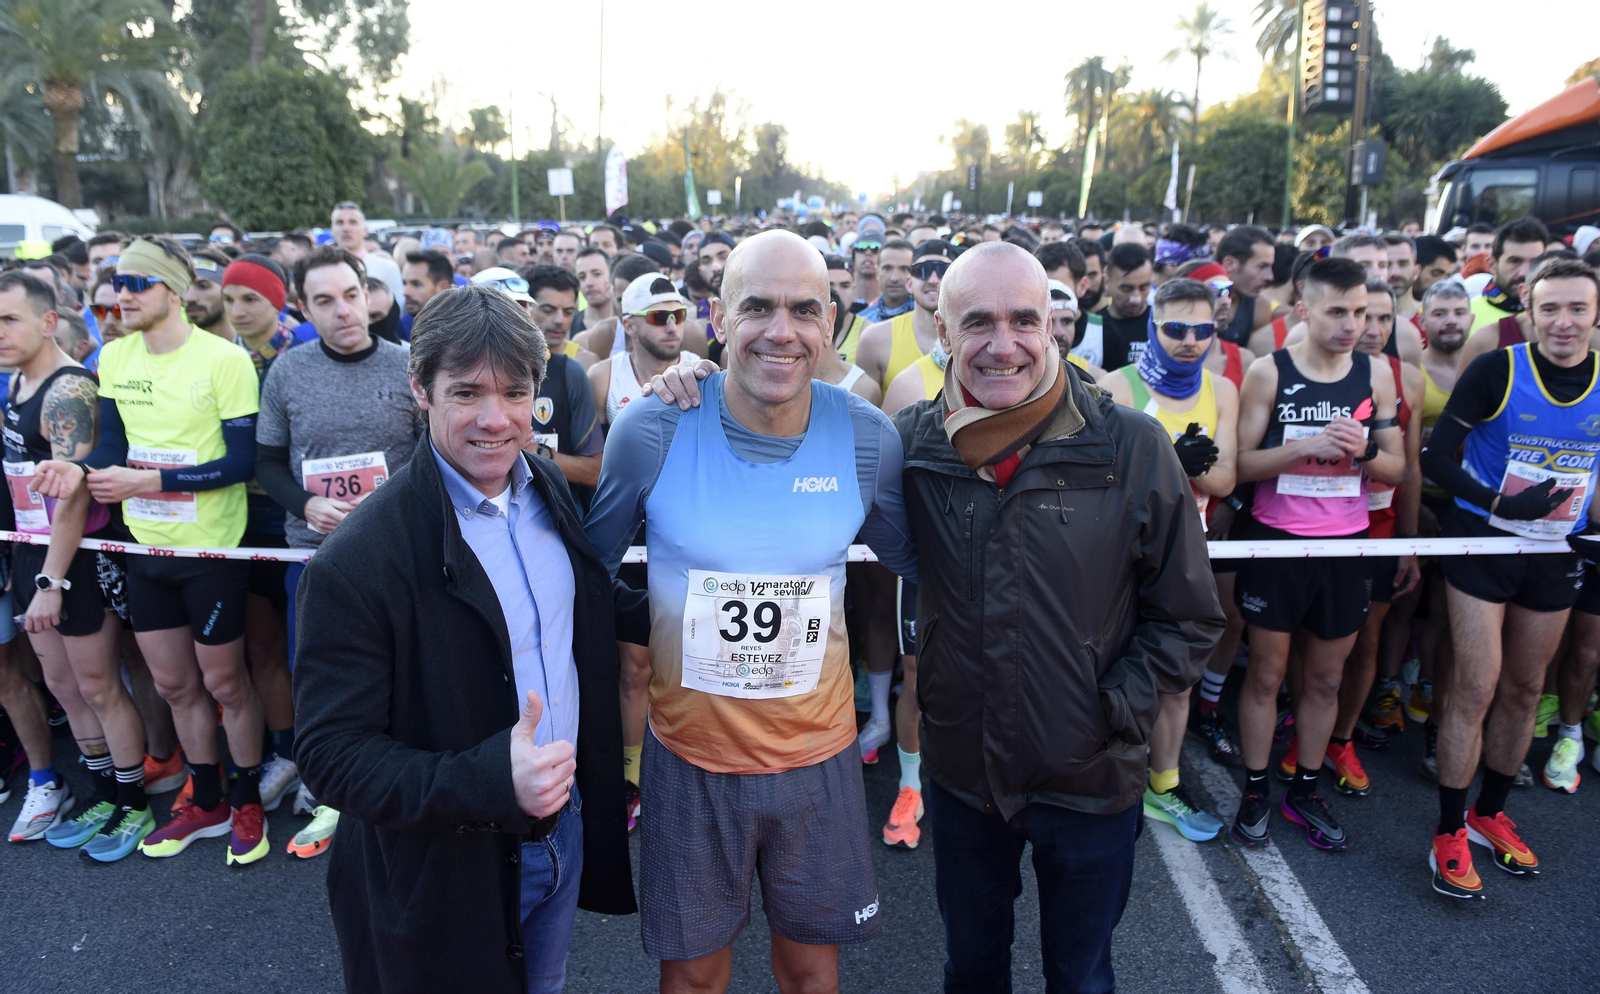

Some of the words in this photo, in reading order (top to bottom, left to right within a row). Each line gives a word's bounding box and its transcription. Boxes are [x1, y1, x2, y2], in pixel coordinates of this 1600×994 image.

[1277, 402, 1299, 422] 26
[1300, 401, 1352, 421] millas
[1508, 433, 1600, 451] CONSTRUCCIONES
[321, 474, 361, 498] 736
[792, 476, 839, 493] HOKA
[720, 580, 746, 595] edp
[765, 580, 807, 589] maratón
[774, 585, 806, 596] sevilla
[719, 600, 782, 643] 39
[731, 653, 782, 663] ESTEVEZ
[751, 664, 774, 677] edp
